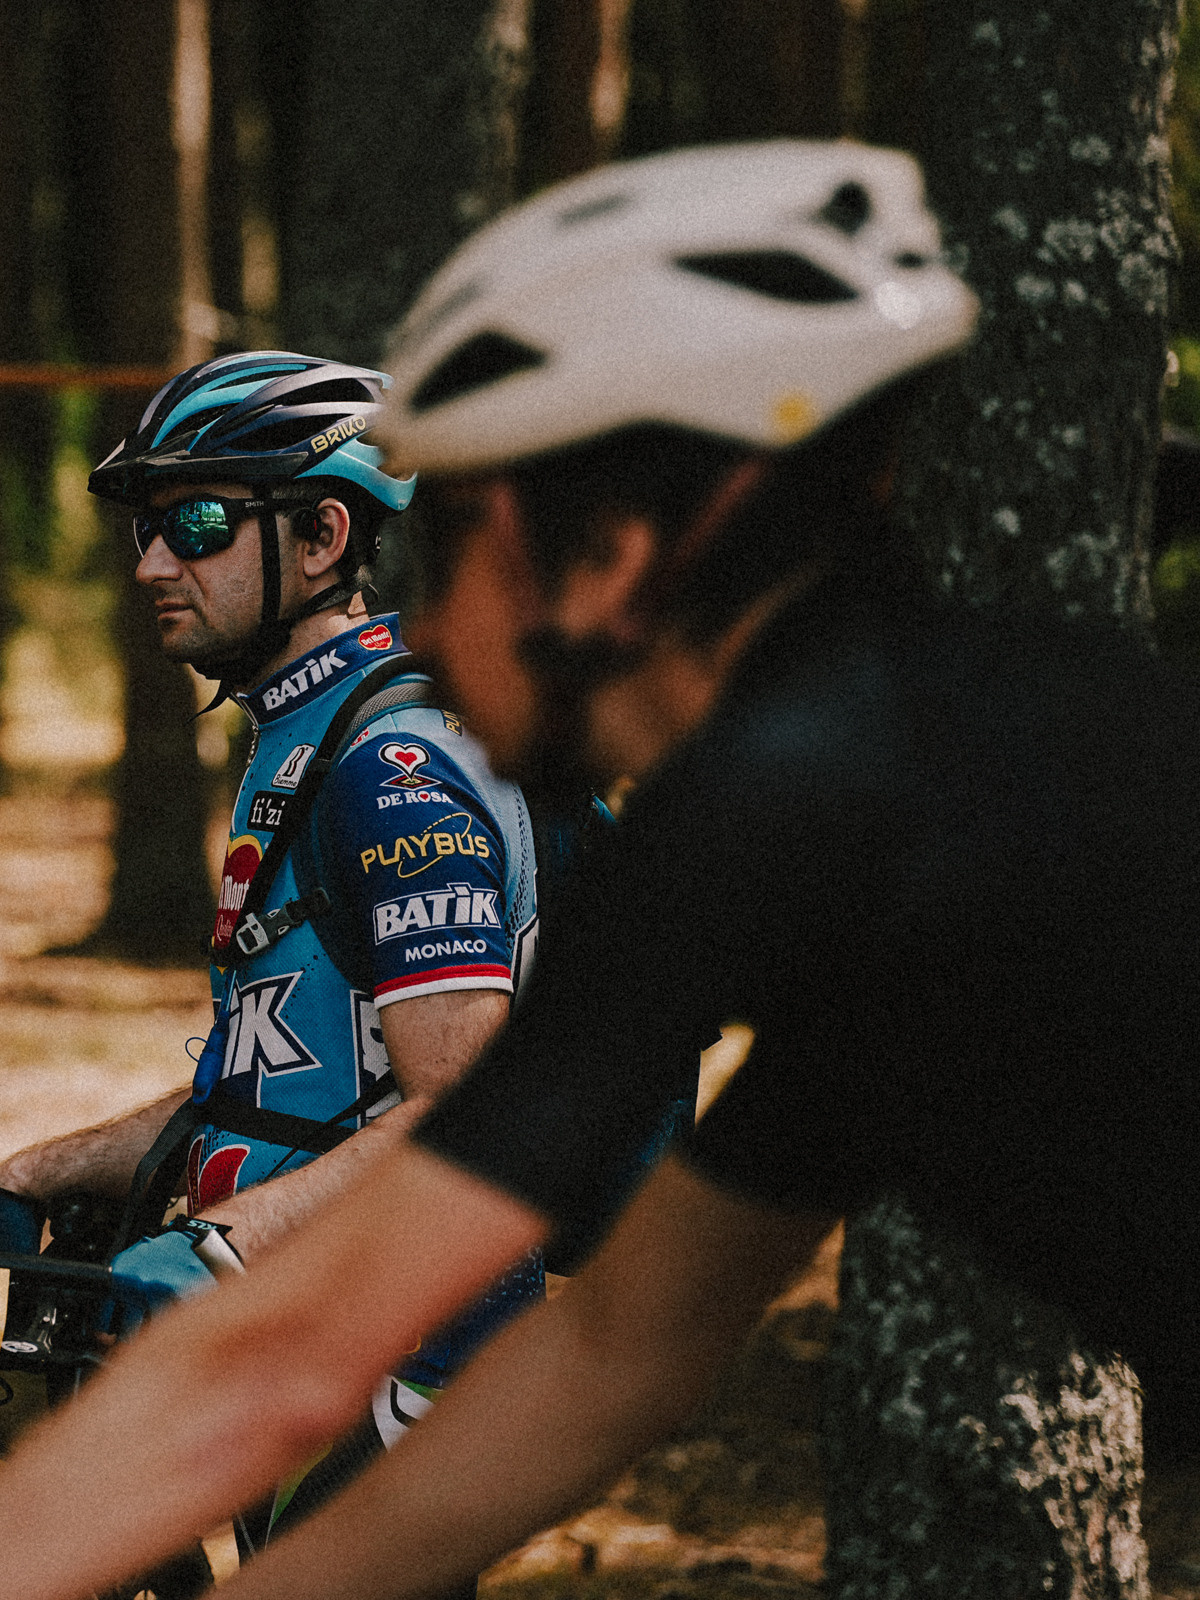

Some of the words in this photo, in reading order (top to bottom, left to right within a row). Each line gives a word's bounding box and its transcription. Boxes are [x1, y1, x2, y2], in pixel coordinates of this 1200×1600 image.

[310, 415, 366, 454] BRIKO
[244, 500, 265, 508] SMITH
[250, 797, 286, 826] fi'zi
[376, 792, 403, 810] DE
[404, 790, 454, 804] ROSA
[360, 832, 490, 874] PLAYBUS
[405, 939, 487, 963] MONACO
